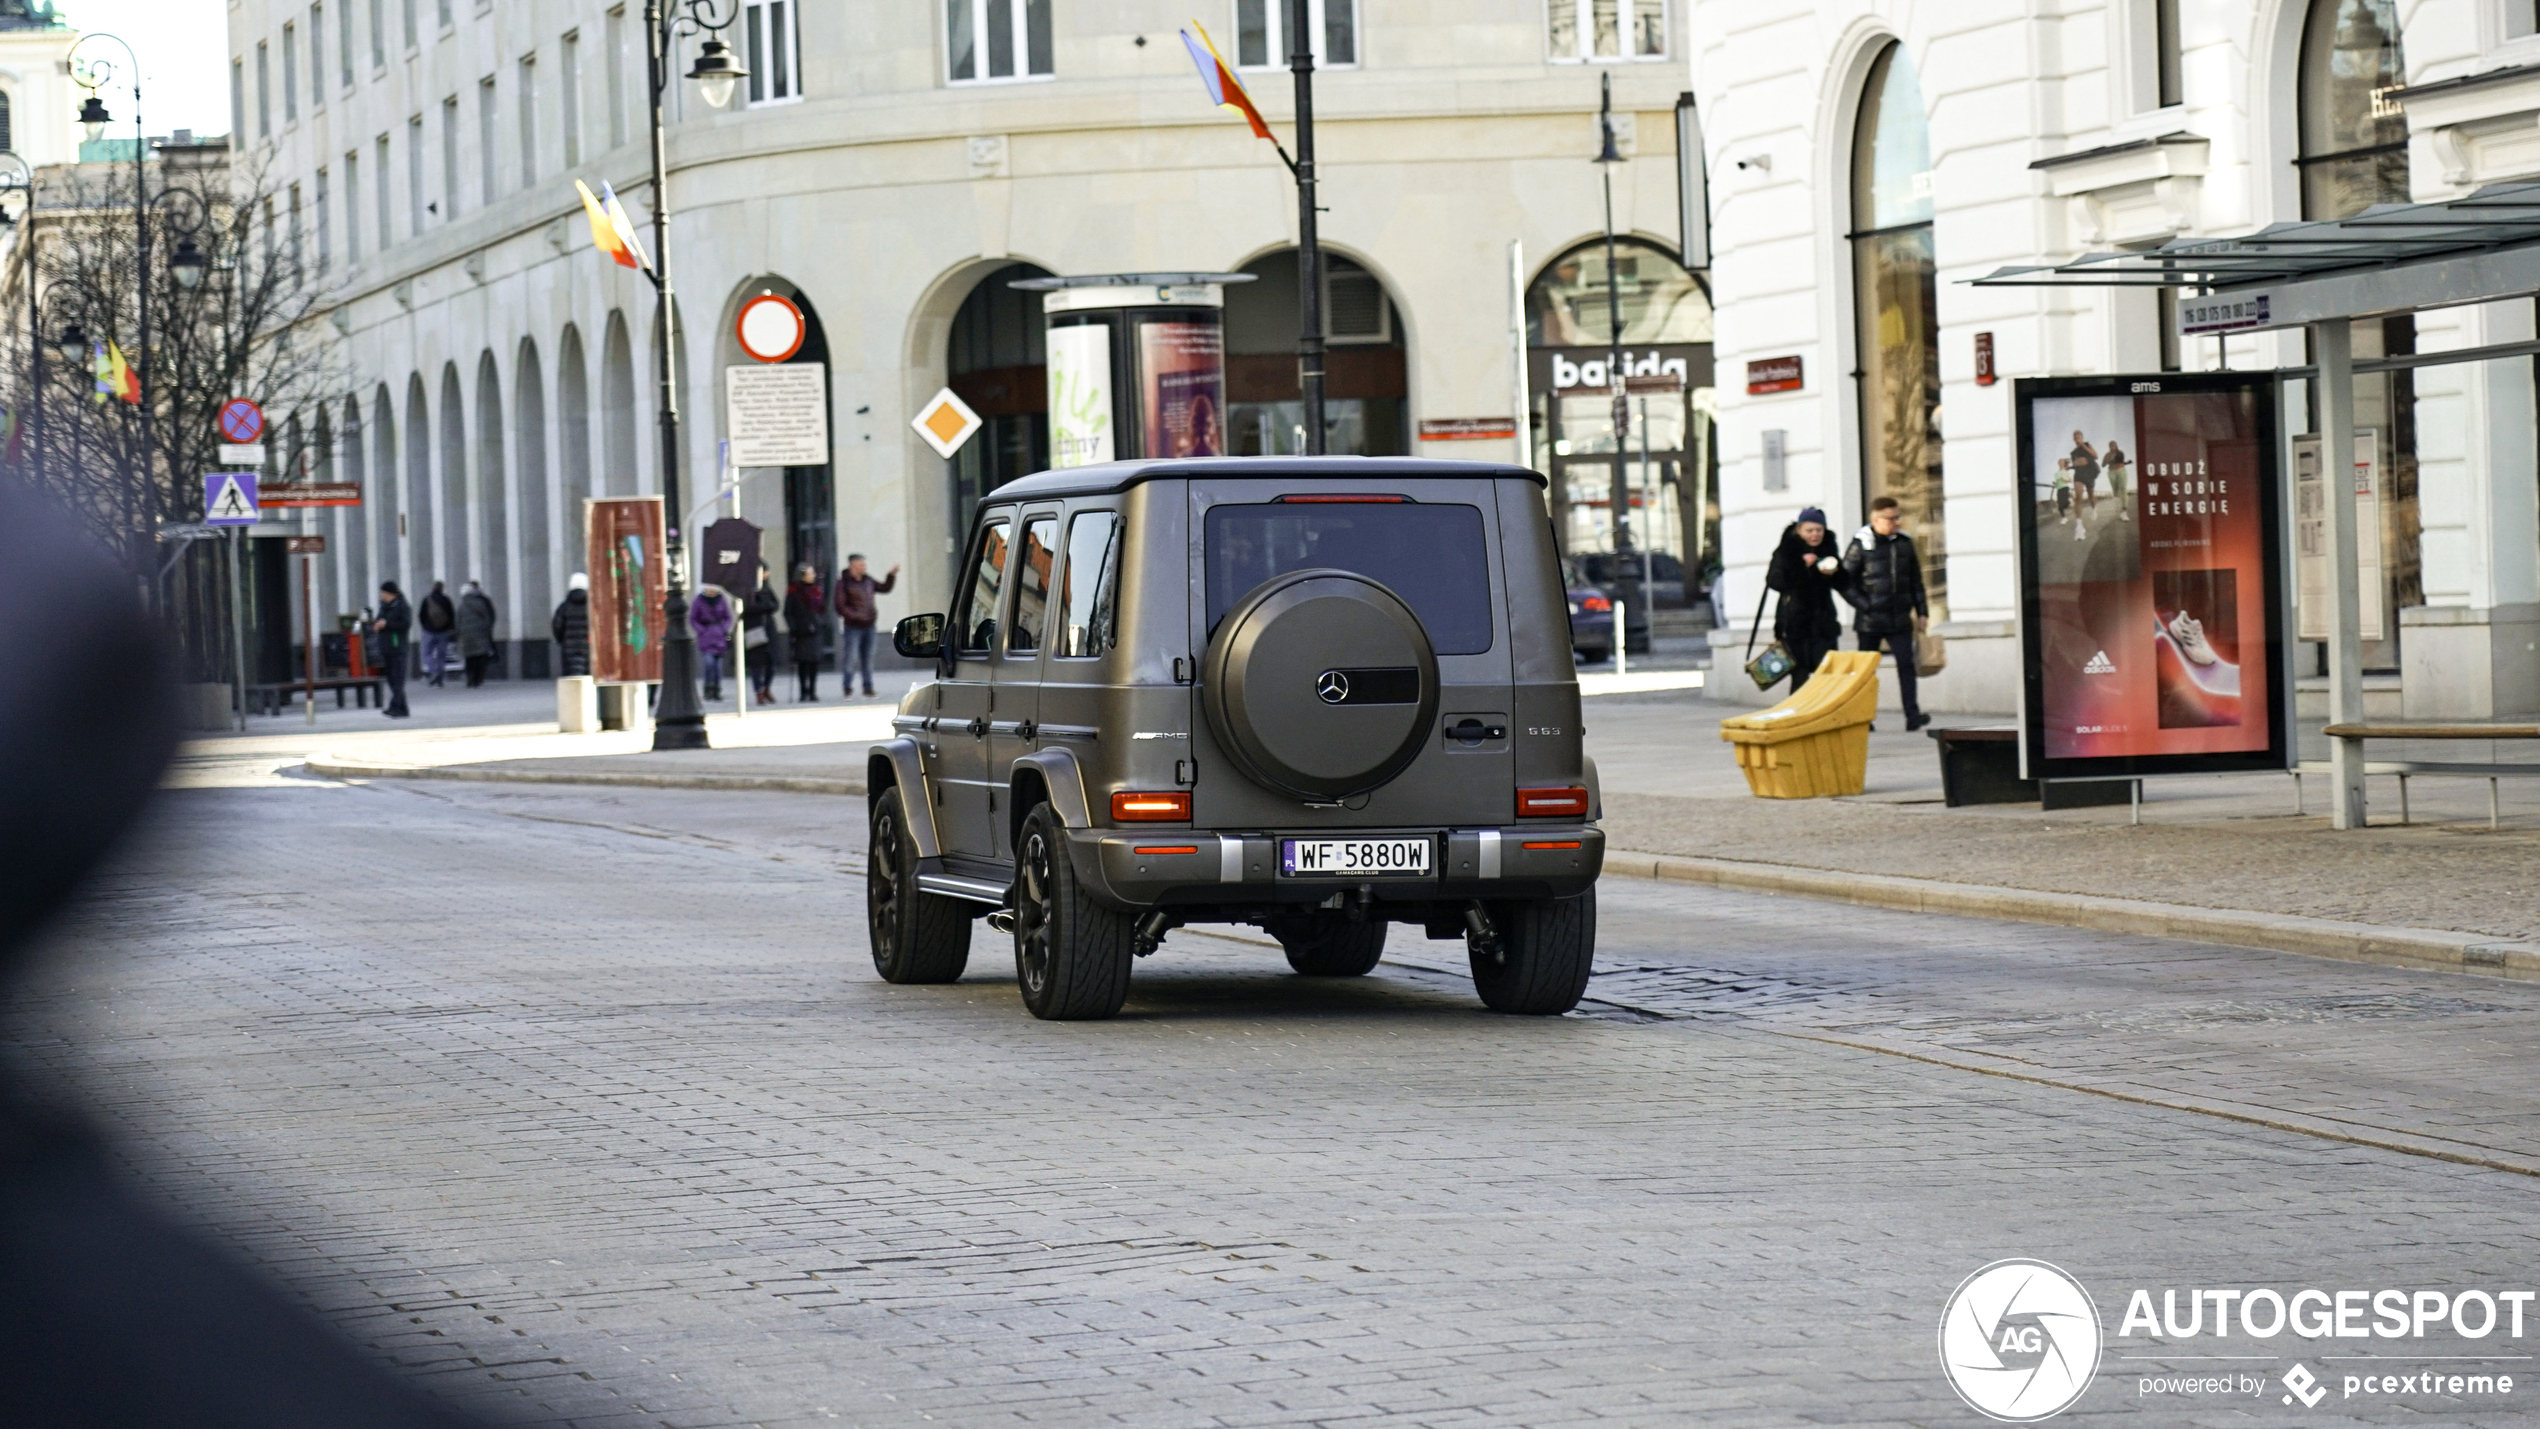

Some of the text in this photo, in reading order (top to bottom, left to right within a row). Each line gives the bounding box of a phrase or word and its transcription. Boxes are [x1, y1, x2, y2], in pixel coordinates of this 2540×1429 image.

[2131, 382, 2161, 393] ams
[2147, 459, 2205, 476] OBUDŹ
[2148, 480, 2227, 496] W SOBIE
[2148, 500, 2229, 516] ENERGIĘ
[2083, 665, 2116, 674] adidas
[1302, 843, 1422, 869] WF 5880W
